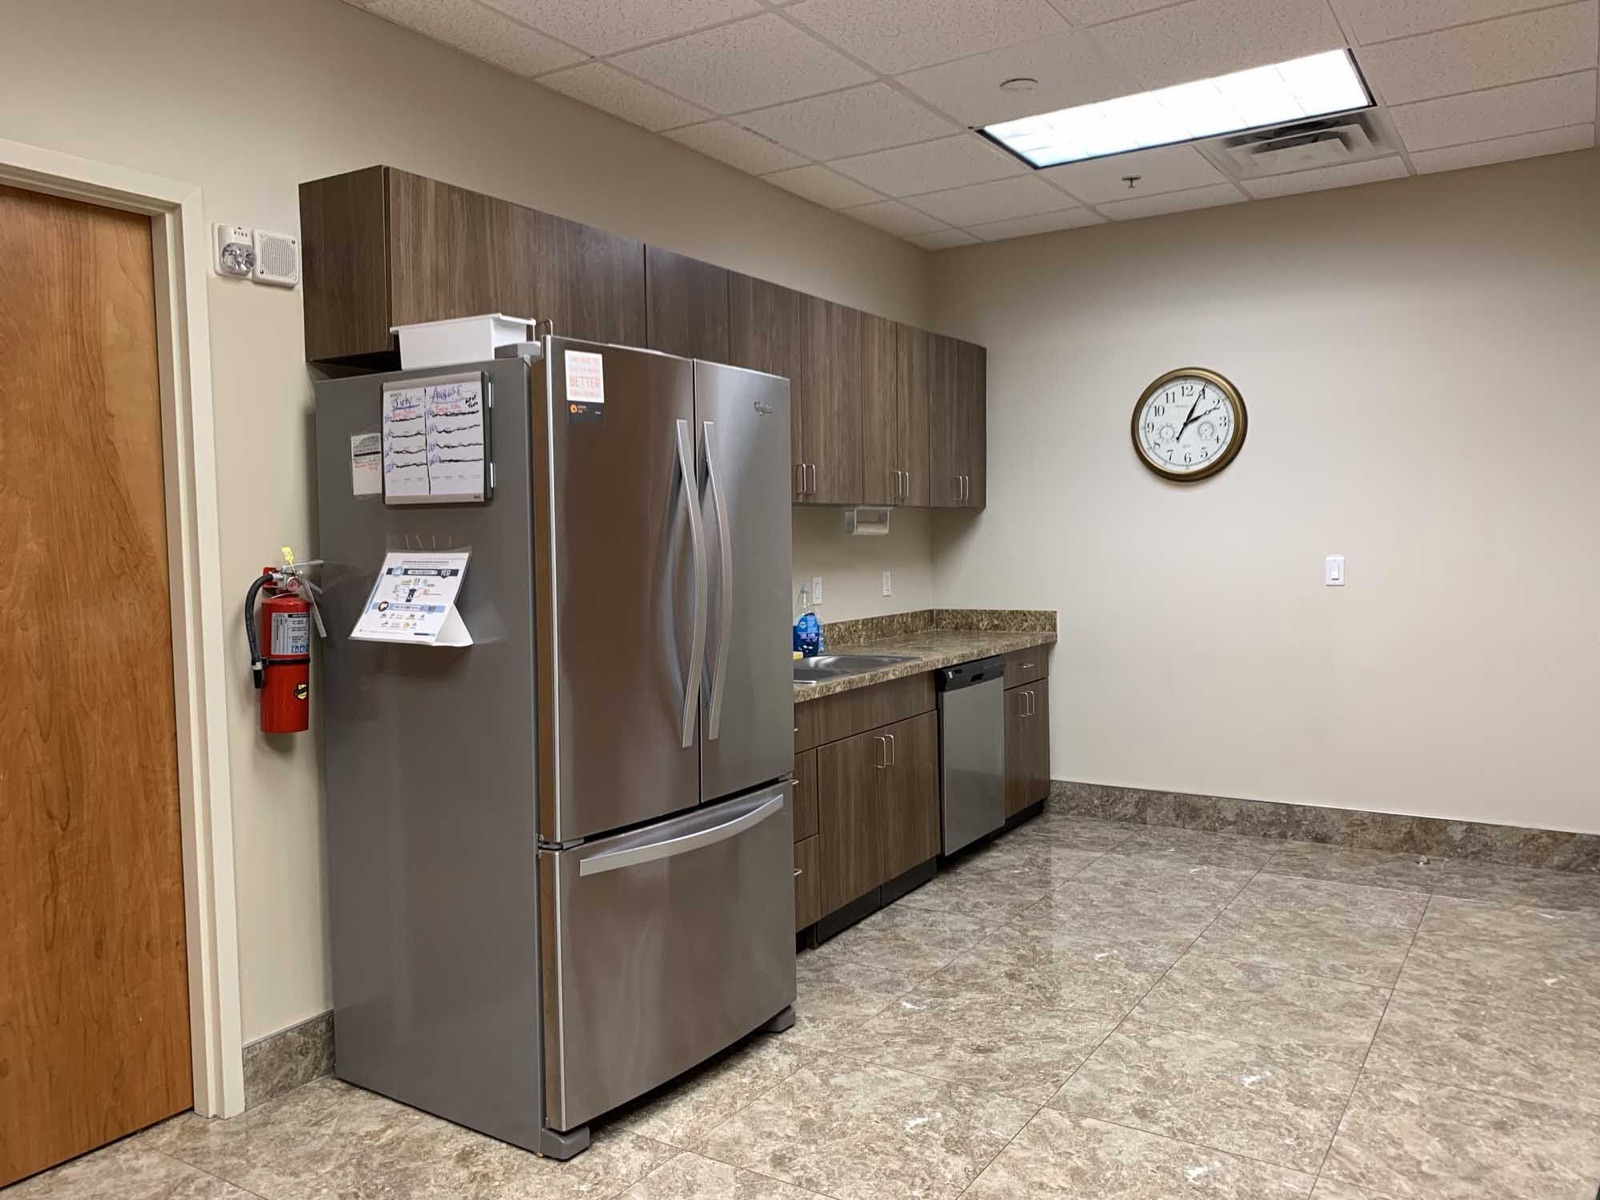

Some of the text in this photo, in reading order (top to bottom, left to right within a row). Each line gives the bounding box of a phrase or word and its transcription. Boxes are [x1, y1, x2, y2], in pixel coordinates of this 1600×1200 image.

[569, 375, 601, 389] BETTER
[1181, 385, 1194, 397] 12
[1165, 391, 1175, 404] 11
[1154, 405, 1165, 417] 10
[1147, 422, 1154, 433] 9
[1219, 416, 1227, 428] 3
[1214, 435, 1220, 444] 4
[1166, 449, 1174, 461] 7
[1183, 452, 1191, 464] 6
[1200, 447, 1208, 458] 5
